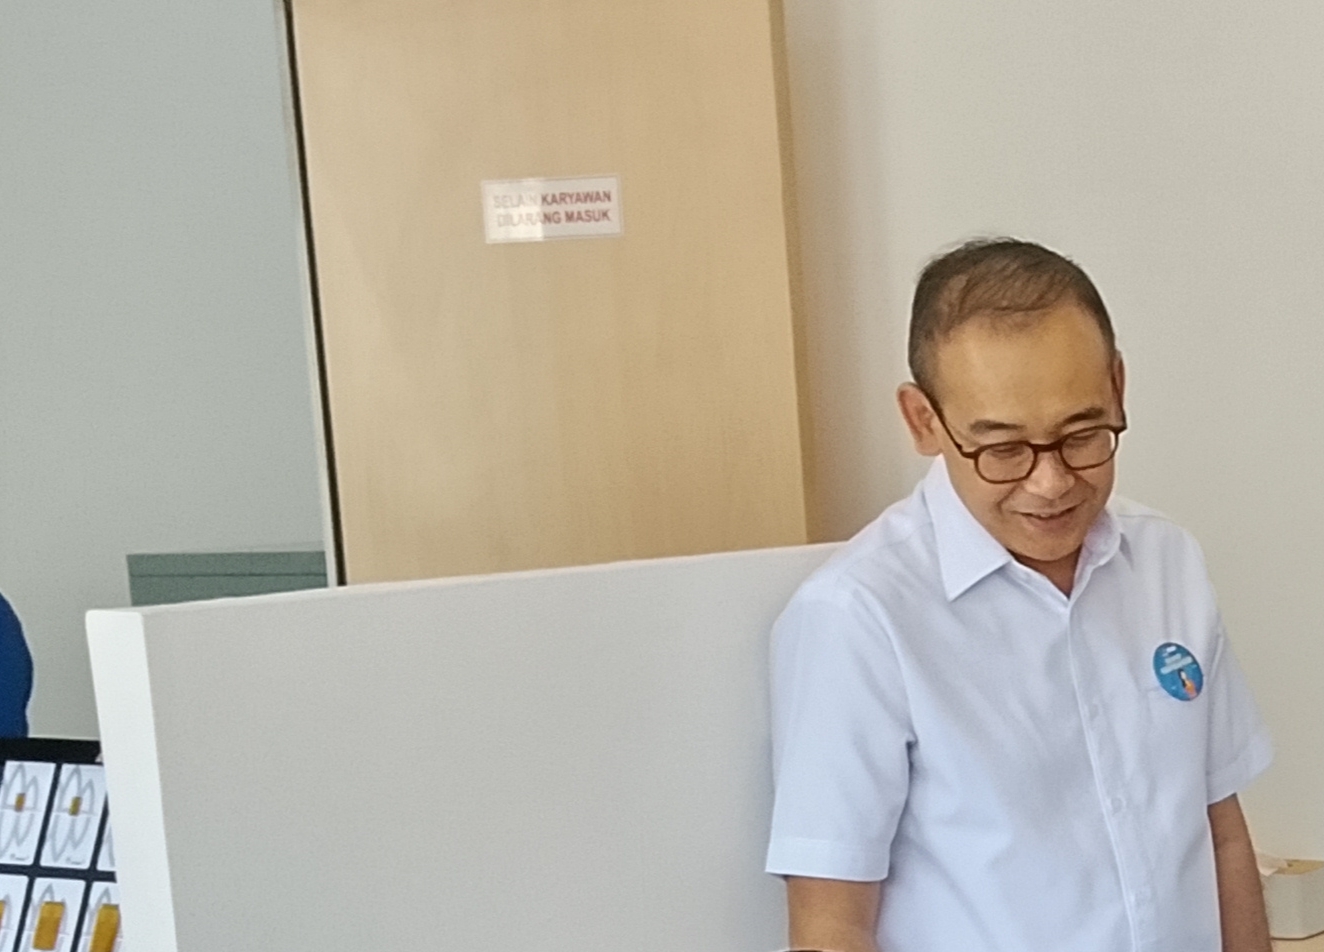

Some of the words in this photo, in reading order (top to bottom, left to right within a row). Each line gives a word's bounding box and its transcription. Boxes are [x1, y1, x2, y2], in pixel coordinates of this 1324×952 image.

[541, 190, 612, 206] KARYAWAN
[497, 211, 562, 227] DILARANG
[565, 209, 611, 224] MASUK
